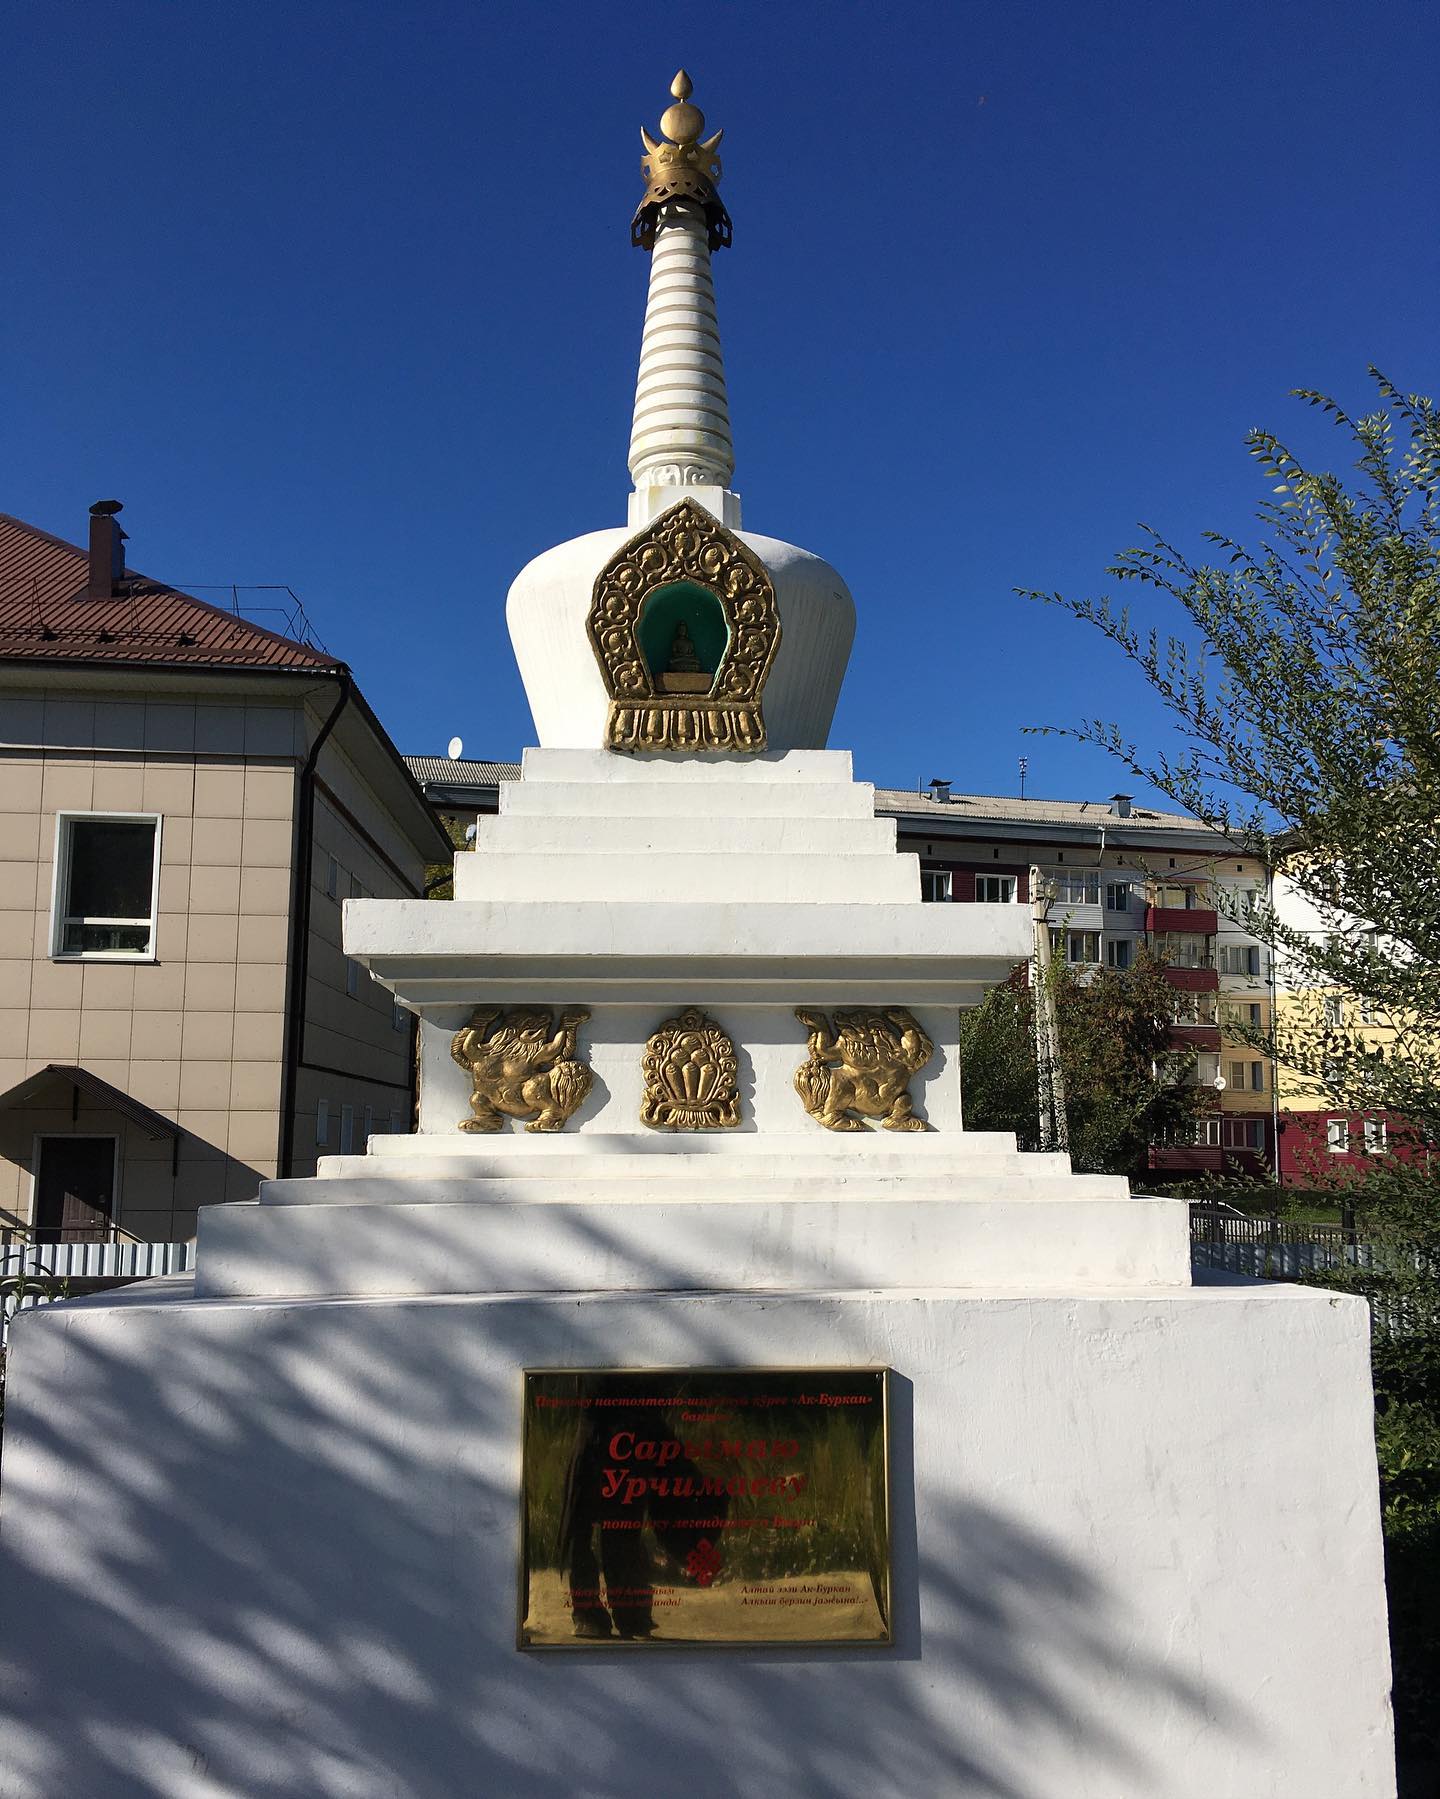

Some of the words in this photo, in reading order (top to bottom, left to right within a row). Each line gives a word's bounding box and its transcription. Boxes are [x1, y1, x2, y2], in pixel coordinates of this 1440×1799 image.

[608, 1431, 801, 1467] Сарымаю
[601, 1467, 808, 1505] Урчимаеву
[672, 1514, 769, 1530] легендаро
[741, 1585, 775, 1594] Алтай
[800, 1584, 851, 1595] Ак-Буркан
